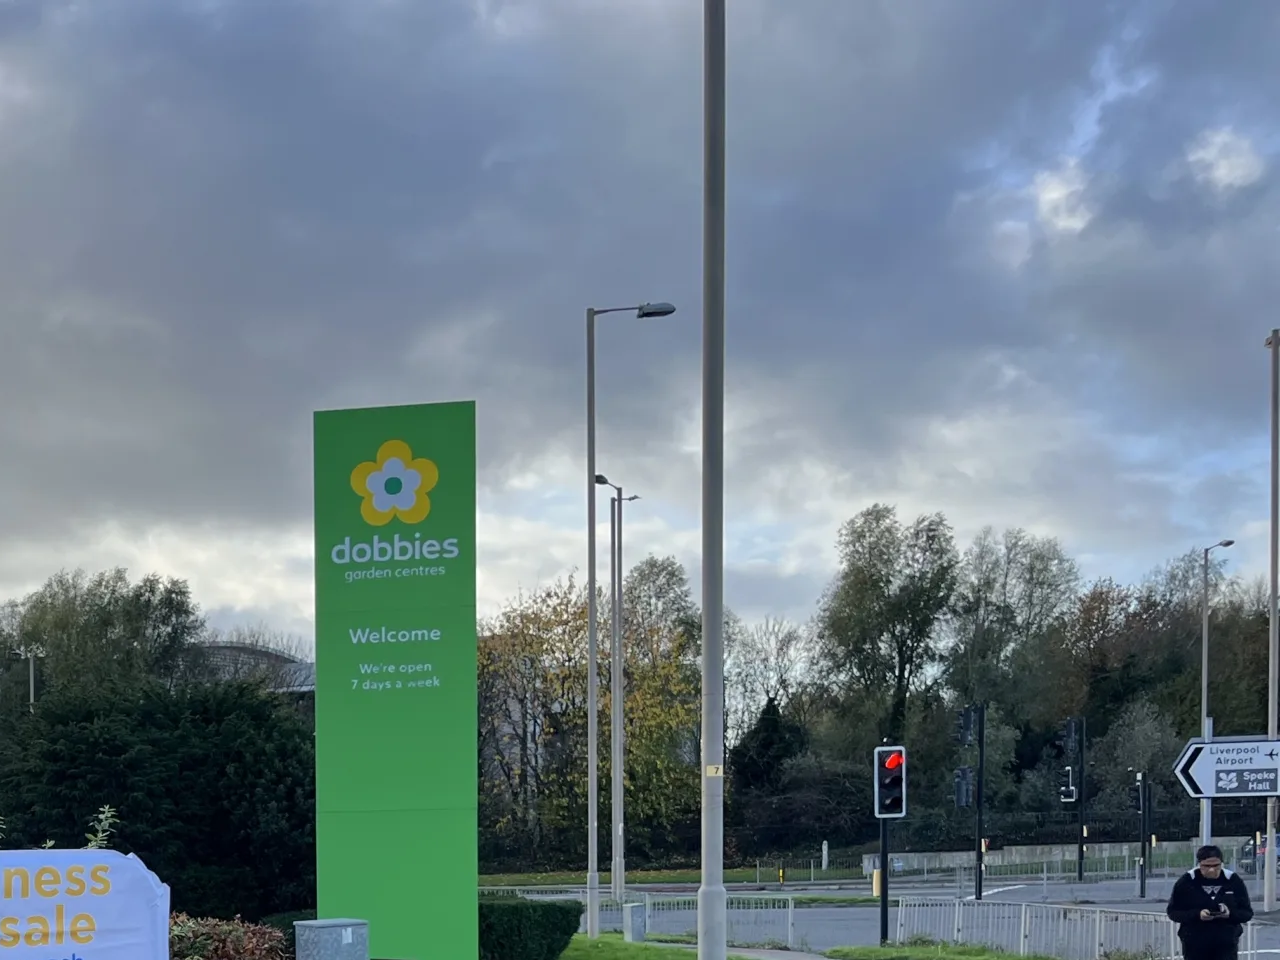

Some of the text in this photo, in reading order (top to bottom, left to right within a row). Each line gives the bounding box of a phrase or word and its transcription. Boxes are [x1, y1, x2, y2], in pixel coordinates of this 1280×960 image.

[331, 532, 459, 564] dobbies
[345, 565, 446, 583] garden centres
[349, 626, 441, 644] Welcome
[359, 663, 432, 674] We're open
[351, 675, 440, 691] 7 days a week
[1209, 746, 1260, 755] Liverpool
[1215, 757, 1253, 765] Airport
[714, 766, 720, 775] 7
[1243, 771, 1276, 781] Speke
[1248, 782, 1270, 790] Hall
